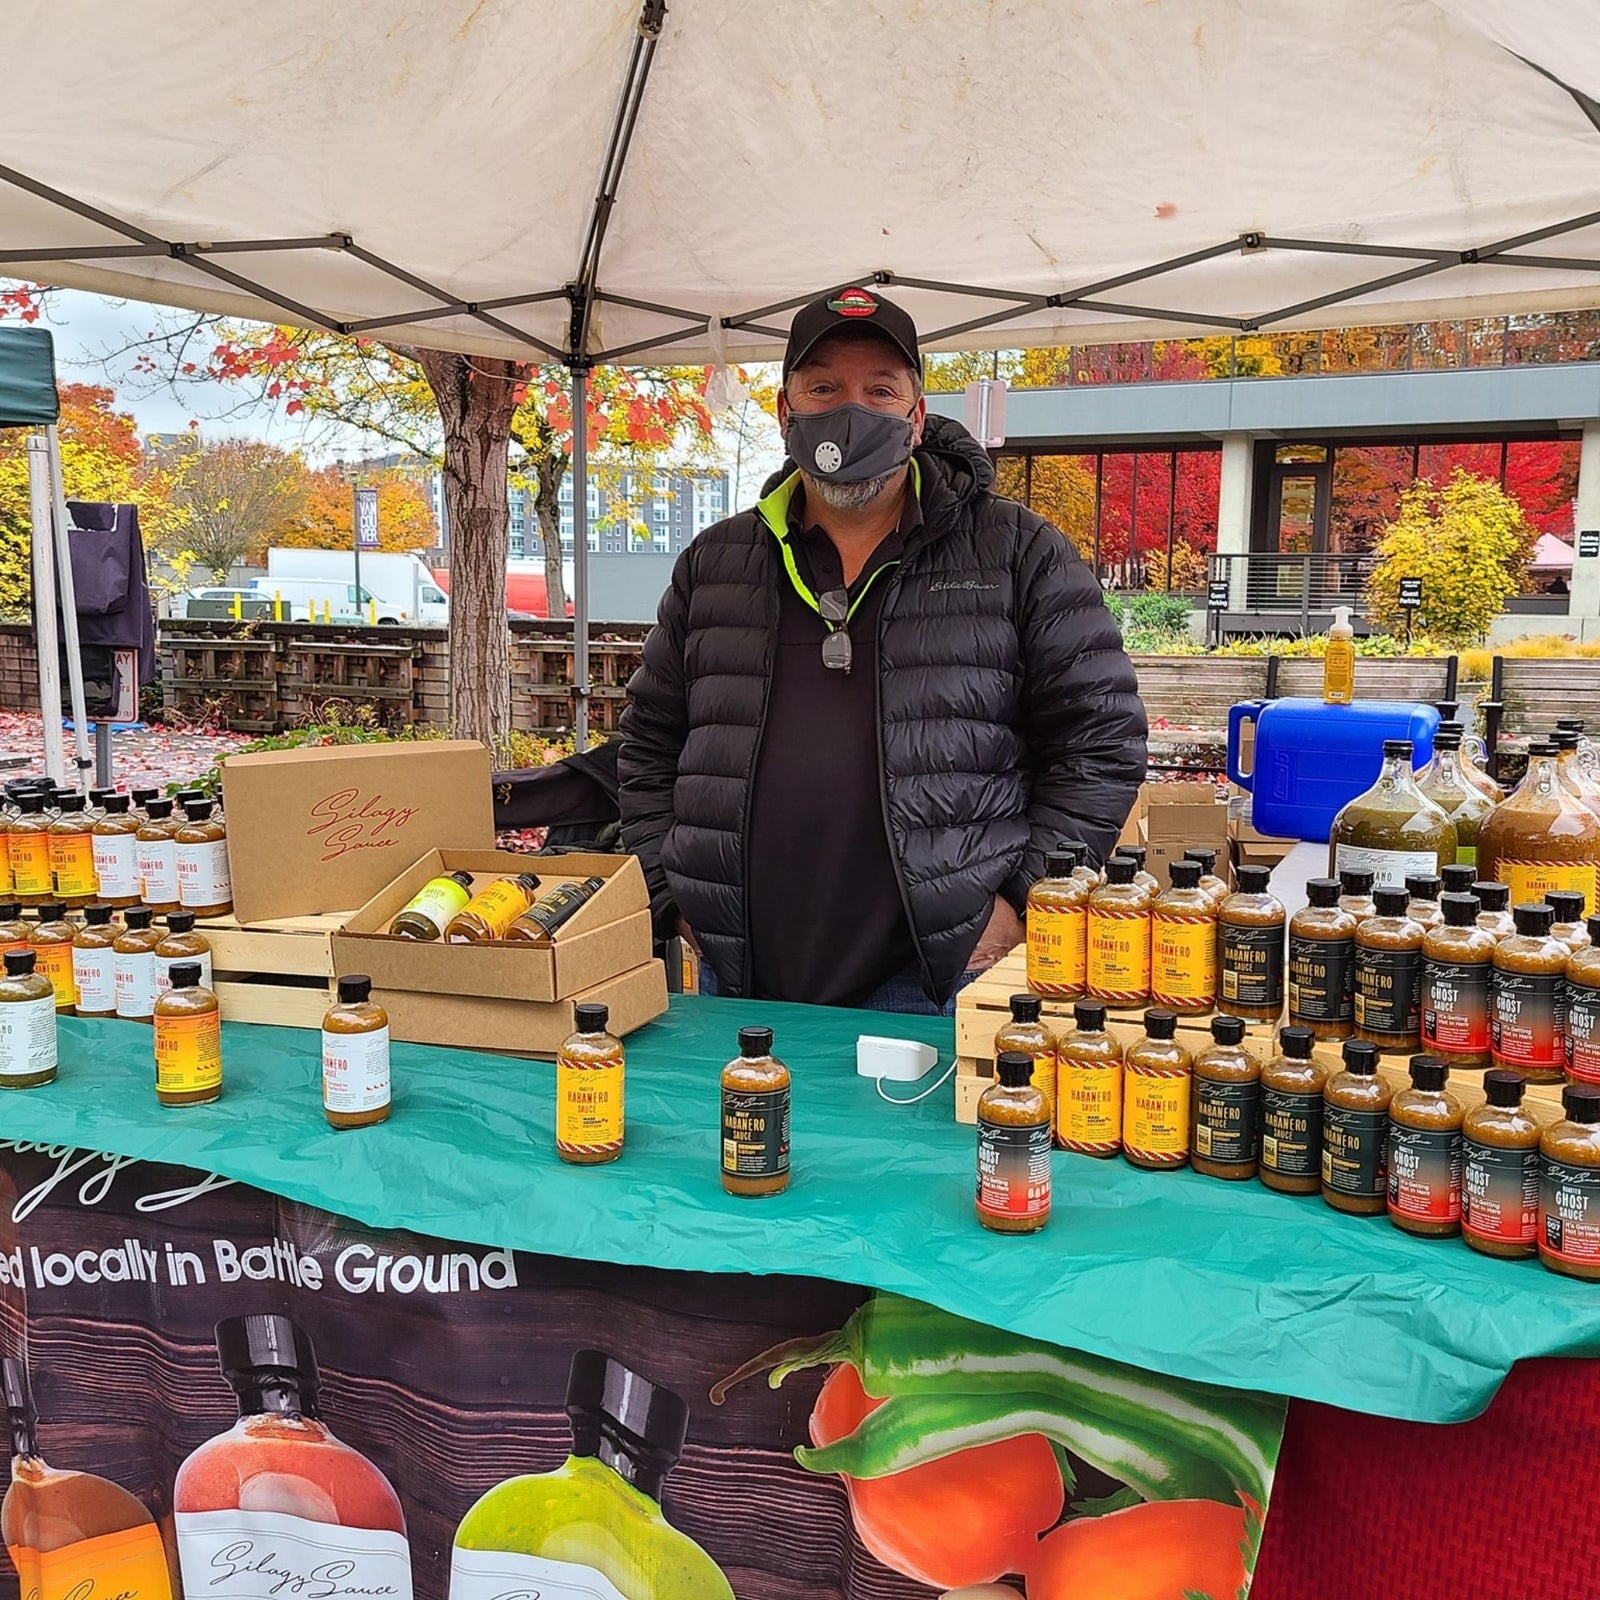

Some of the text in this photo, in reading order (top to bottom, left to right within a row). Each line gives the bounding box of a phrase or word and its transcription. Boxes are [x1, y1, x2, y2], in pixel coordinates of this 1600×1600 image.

[360, 502, 376, 516] VAN
[360, 516, 376, 528] COU
[360, 529, 377, 542] VER
[306, 788, 420, 836] Silagy
[321, 824, 399, 862] Sauce
[1526, 881, 1558, 889] HABANERO
[1035, 945, 1049, 953] SAUCE
[1093, 938, 1130, 952] HABANERO
[1100, 952, 1117, 961] SAUCE
[1162, 956, 1177, 966] SAUCE
[1225, 946, 1266, 963] HABANERO
[1234, 962, 1253, 972] SAUCE
[1362, 985, 1379, 997] SAUCE
[1431, 986, 1459, 1002] GHOST
[1434, 1000, 1454, 1012] SAUCE
[1497, 996, 1522, 1013] GHOST
[1499, 1010, 1517, 1024] SAUCE
[1569, 1010, 1595, 1029] GHOST
[1572, 1026, 1590, 1039] SAUCE
[568, 1091, 608, 1103] HABANERO
[1071, 1089, 1111, 1102] HABANERO
[578, 1105, 596, 1113] SAUCE
[1082, 1104, 1100, 1112] SAUCE
[1136, 1096, 1177, 1112] HABANERO
[1199, 1101, 1240, 1120] HABANERO
[724, 1114, 765, 1132] HABANERO
[1146, 1112, 1165, 1122] SAUCE
[1208, 1118, 1227, 1128] SAUCE
[1265, 1112, 1307, 1132] HABANERO
[733, 1131, 751, 1141] SAUCE
[1274, 1128, 1293, 1140] SAUCE
[1394, 1150, 1420, 1170] GHOST
[1397, 1165, 1416, 1179] SAUCE
[1466, 1166, 1491, 1187] GHOST
[1468, 1181, 1485, 1197] SAUCE
[1556, 1191, 1589, 1210] GHOST
[1559, 1207, 1584, 1221] SAUCE
[30, 1238, 158, 1289] locally
[165, 1242, 206, 1286] in
[212, 1237, 324, 1291] Battle
[334, 1244, 518, 1294] Ground
[209, 1540, 400, 1599] Silagy Sauce
